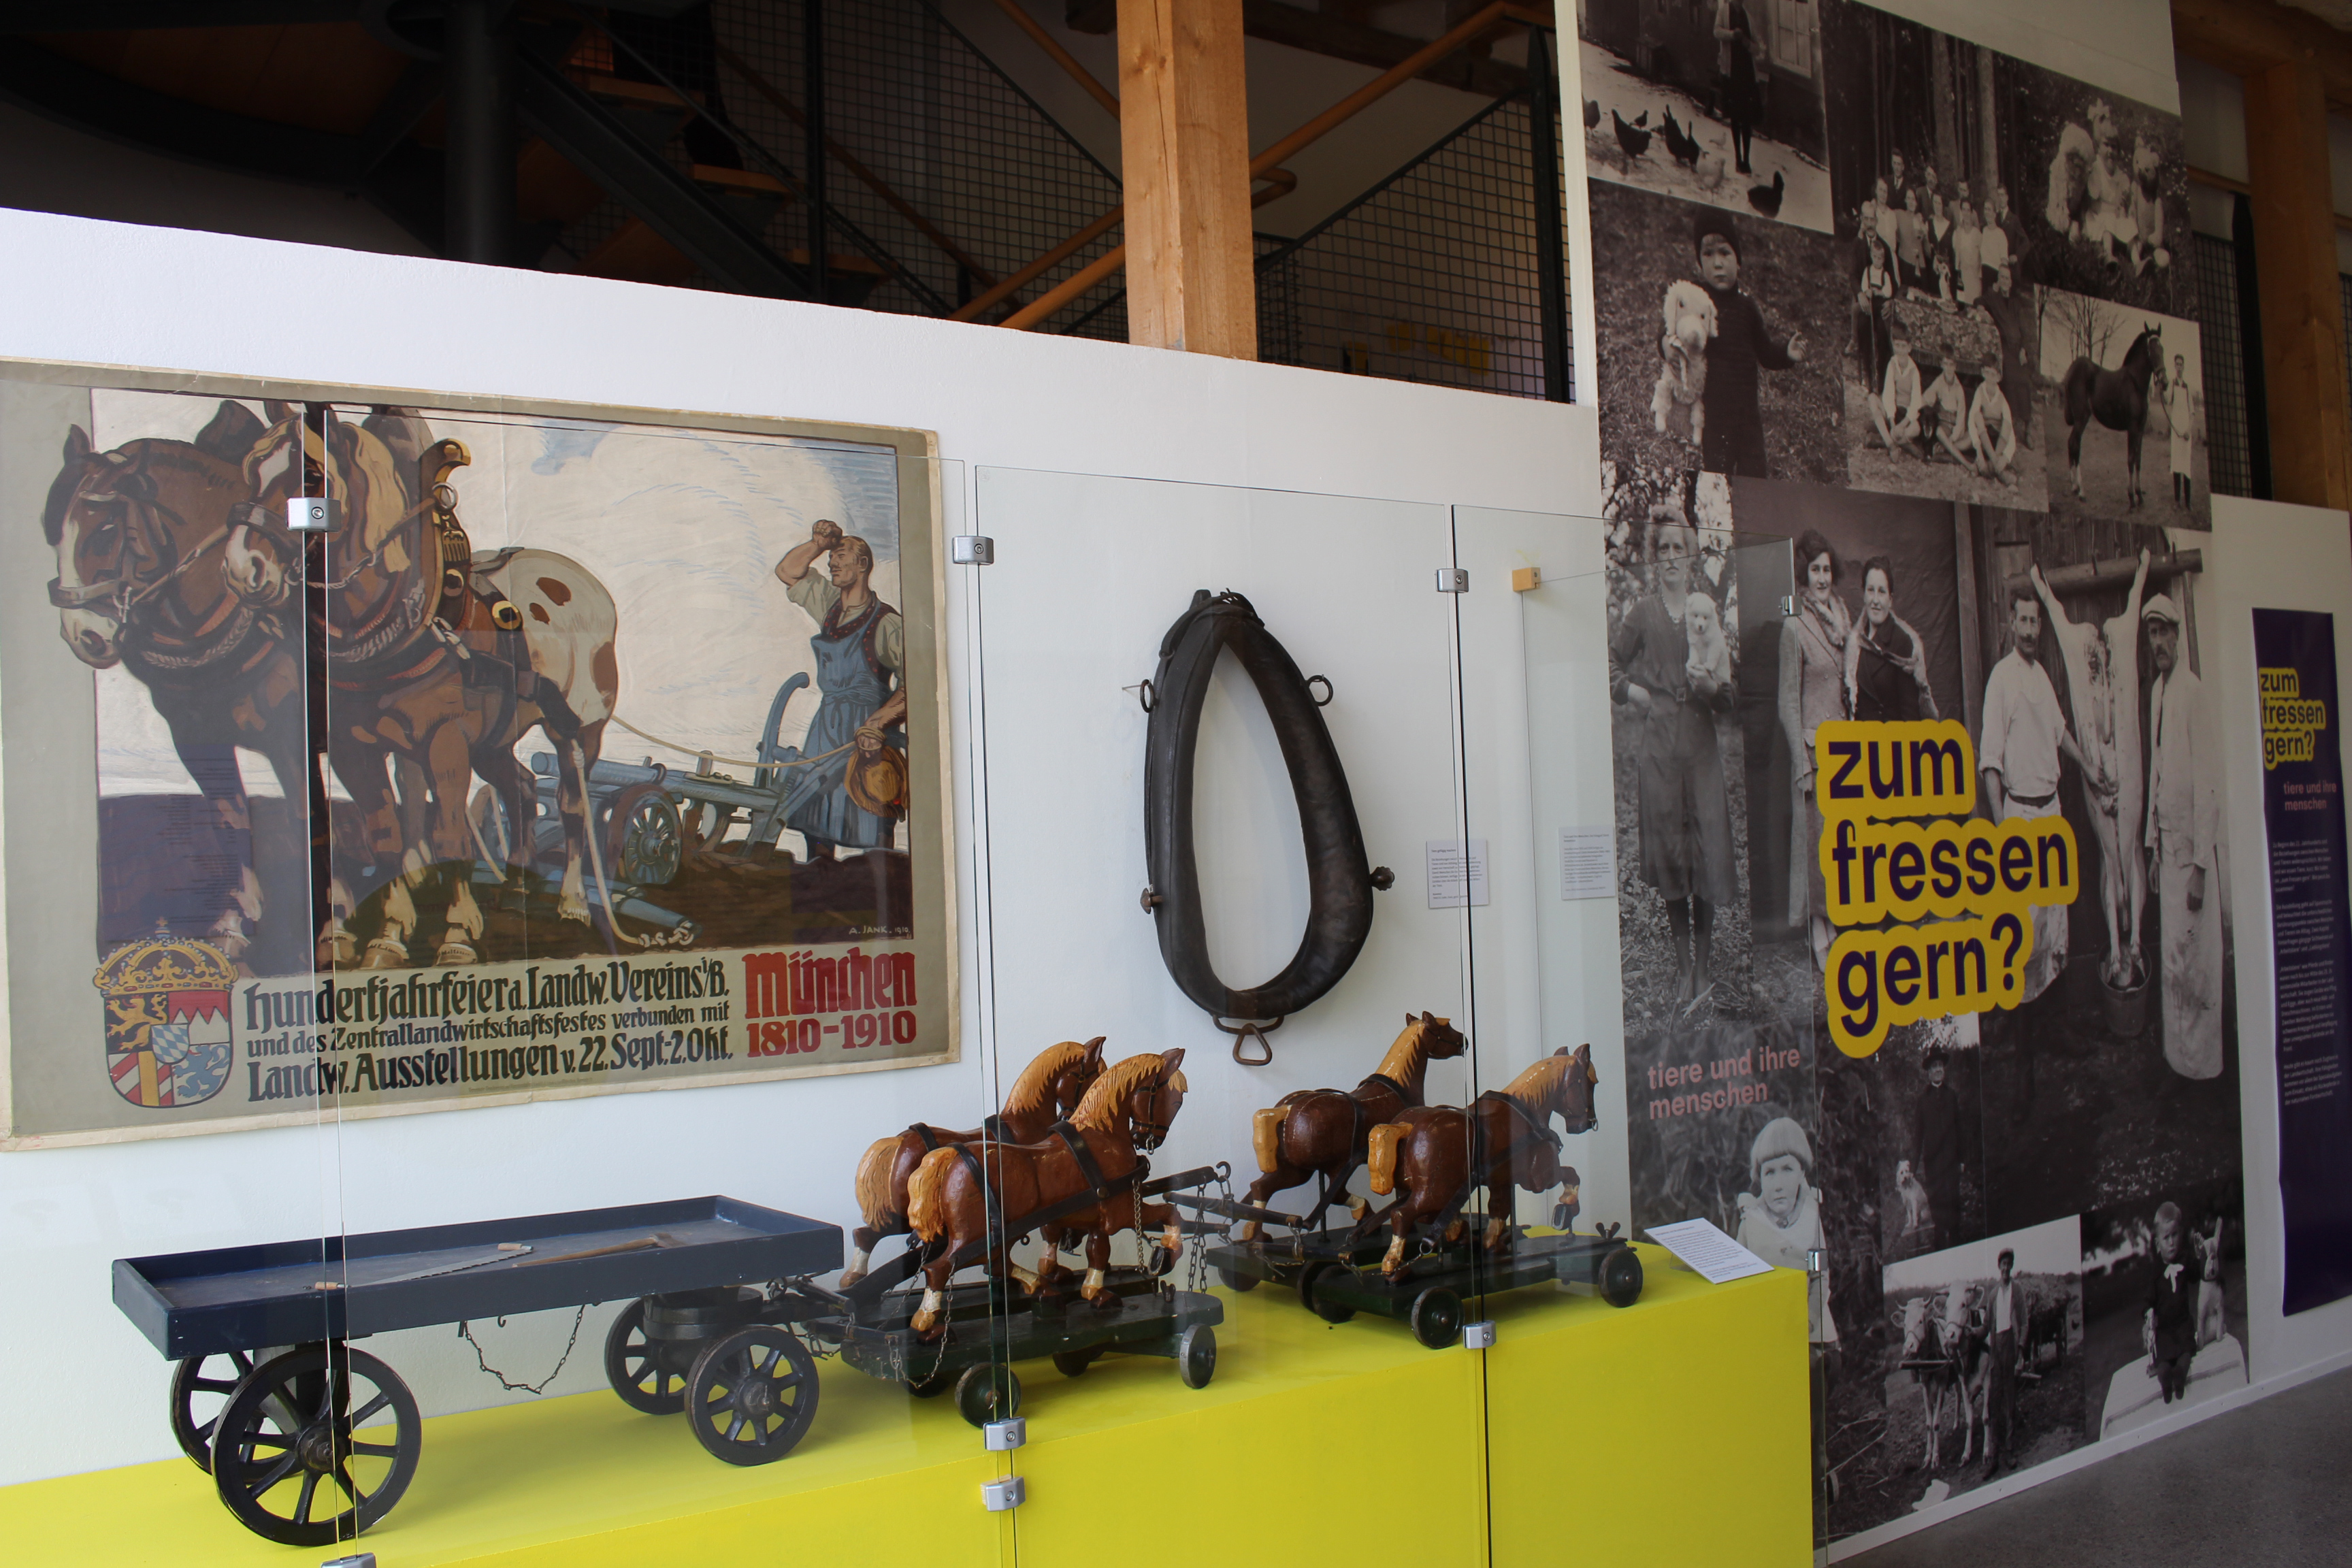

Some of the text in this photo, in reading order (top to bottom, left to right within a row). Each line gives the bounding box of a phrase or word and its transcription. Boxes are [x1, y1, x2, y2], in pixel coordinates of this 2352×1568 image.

[2260, 673, 2297, 692] zum
[2263, 700, 2324, 724] fressen
[1827, 738, 1965, 799] zum
[2264, 730, 2313, 764] gern?
[1832, 820, 2069, 905] fressen
[742, 947, 917, 1019] München
[1837, 913, 2023, 1037] gern?
[246, 1031, 290, 1058] und
[293, 1030, 327, 1054] des
[611, 1004, 695, 1030] verbunden
[700, 1000, 730, 1022] mit
[746, 1010, 917, 1058] 1810-1910
[351, 1043, 559, 1093] Ausstellungen
[1648, 1046, 1801, 1089] tiere und ihre
[1649, 1080, 1768, 1120] menschen
